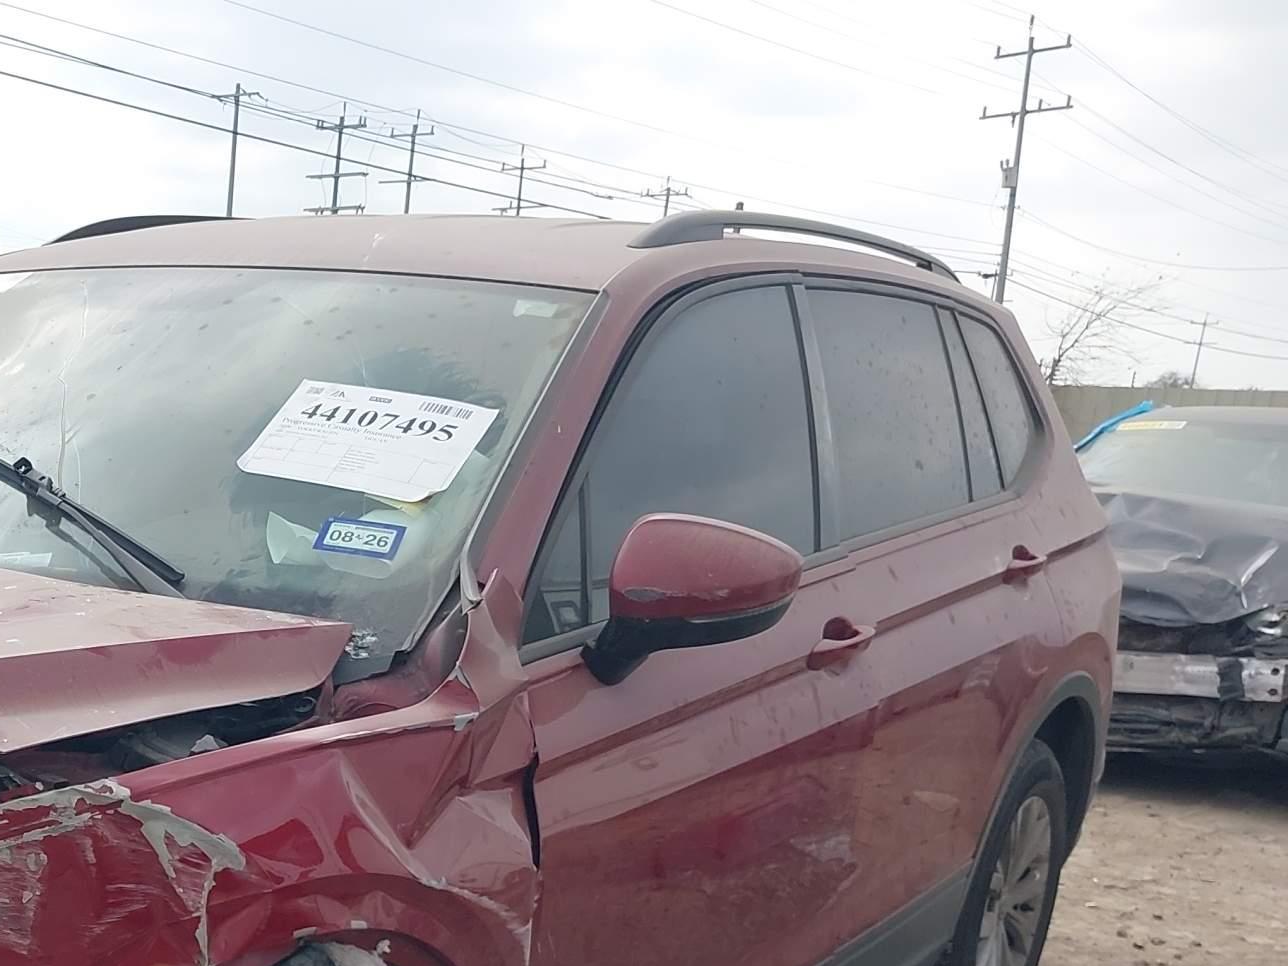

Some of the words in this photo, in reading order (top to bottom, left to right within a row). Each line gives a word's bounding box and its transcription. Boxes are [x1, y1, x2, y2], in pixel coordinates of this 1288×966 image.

[282, 417, 326, 430] Progressive
[327, 423, 361, 434] Casualty
[300, 402, 460, 442] 44107495
